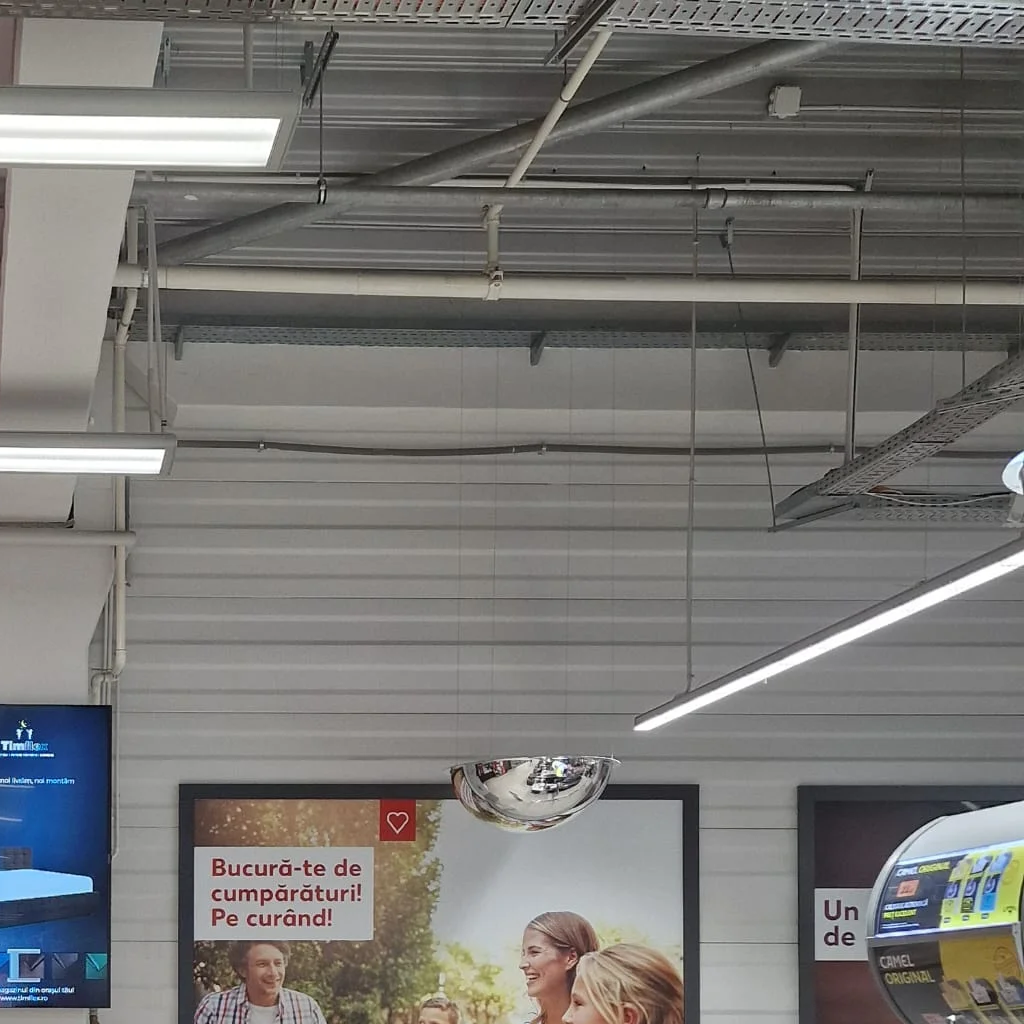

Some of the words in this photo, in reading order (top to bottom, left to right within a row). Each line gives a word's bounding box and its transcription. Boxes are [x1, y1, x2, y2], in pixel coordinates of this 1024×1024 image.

[210, 858, 326, 877] Bucură-te
[334, 858, 362, 877] de
[210, 883, 362, 906] cumpărături!
[210, 909, 239, 927] Pe
[246, 908, 333, 927] curând!
[824, 899, 859, 921] Un
[823, 925, 856, 947] de
[879, 953, 915, 969] CAMEL
[884, 971, 936, 985] ORIGINAL
